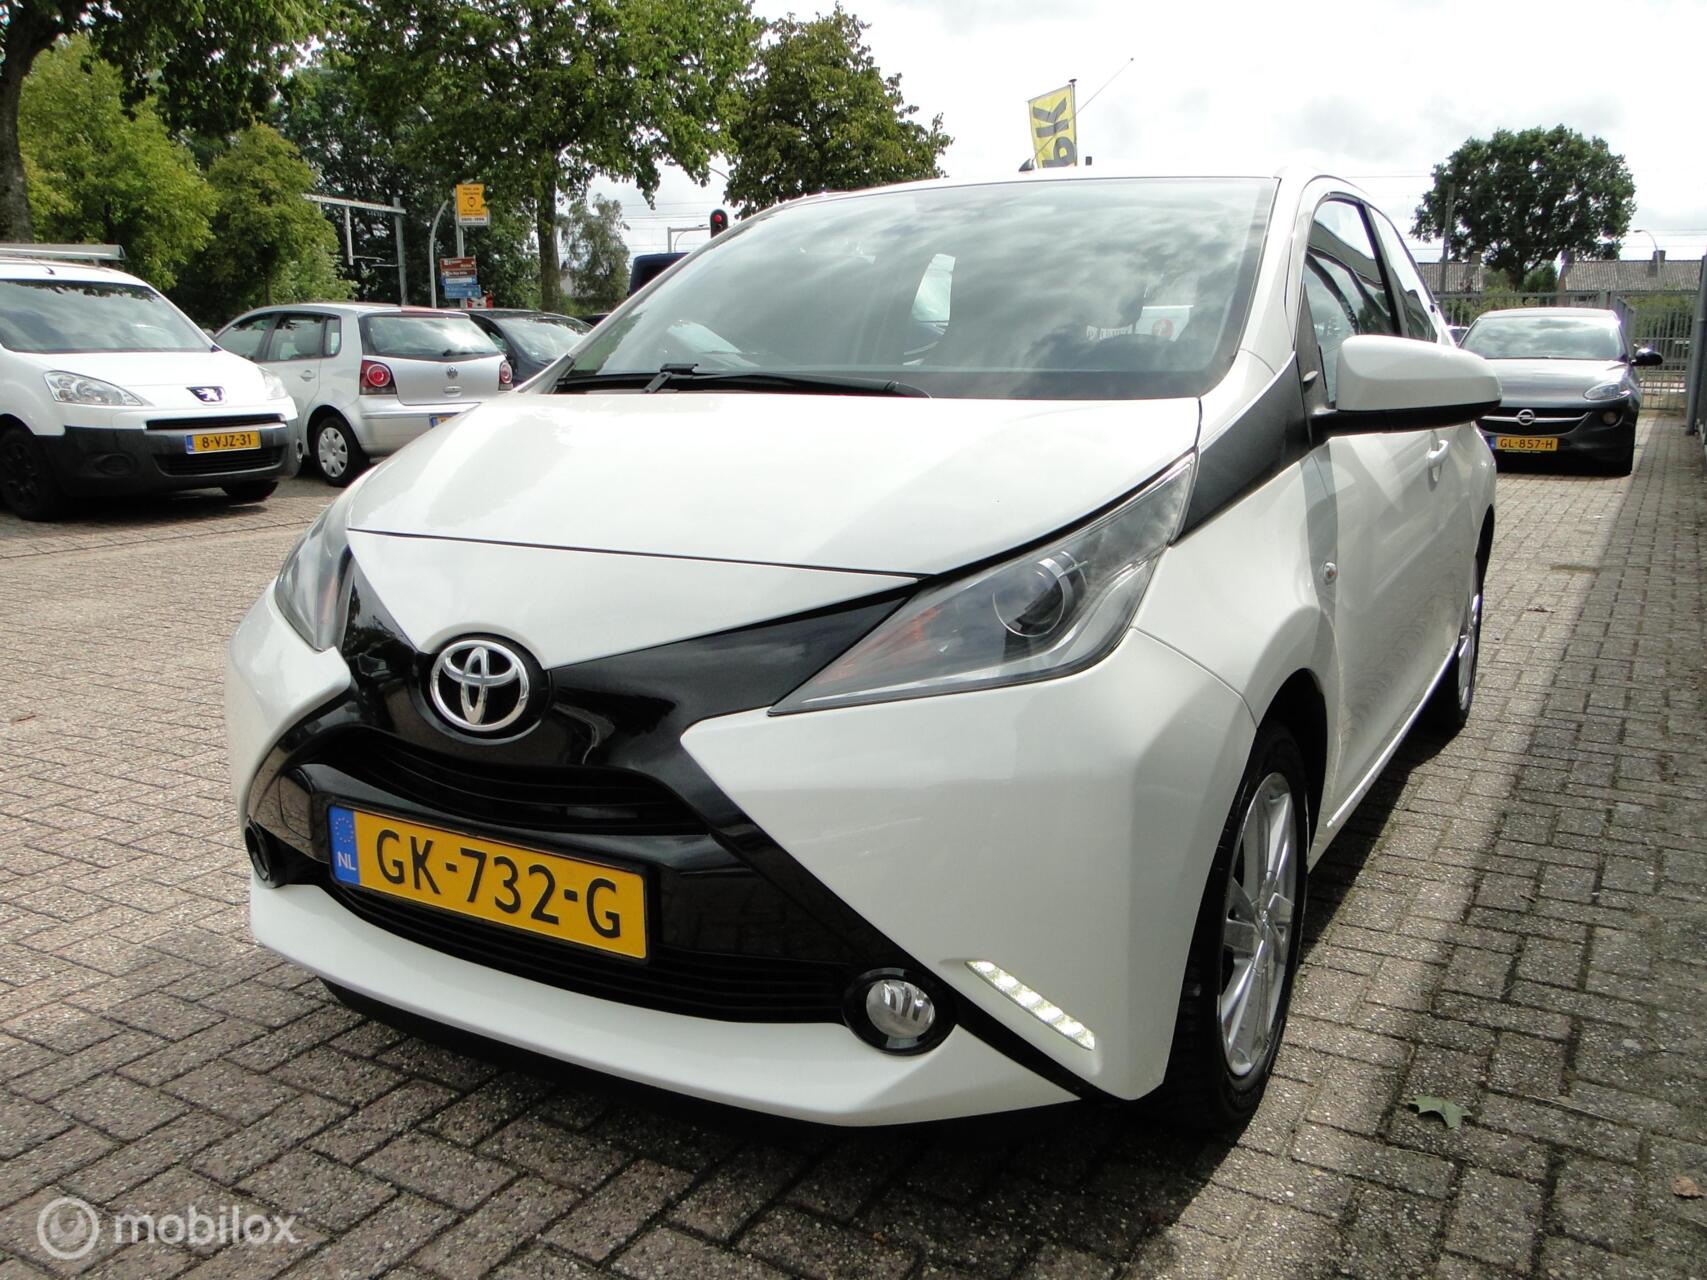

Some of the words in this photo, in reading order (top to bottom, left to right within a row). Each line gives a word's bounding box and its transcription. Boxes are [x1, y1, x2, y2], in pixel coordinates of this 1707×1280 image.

[202, 434, 252, 448] 8-VJZ-31
[1500, 438, 1553, 449] GL-857-H
[337, 851, 356, 872] NL
[376, 829, 621, 939] GK-732-G
